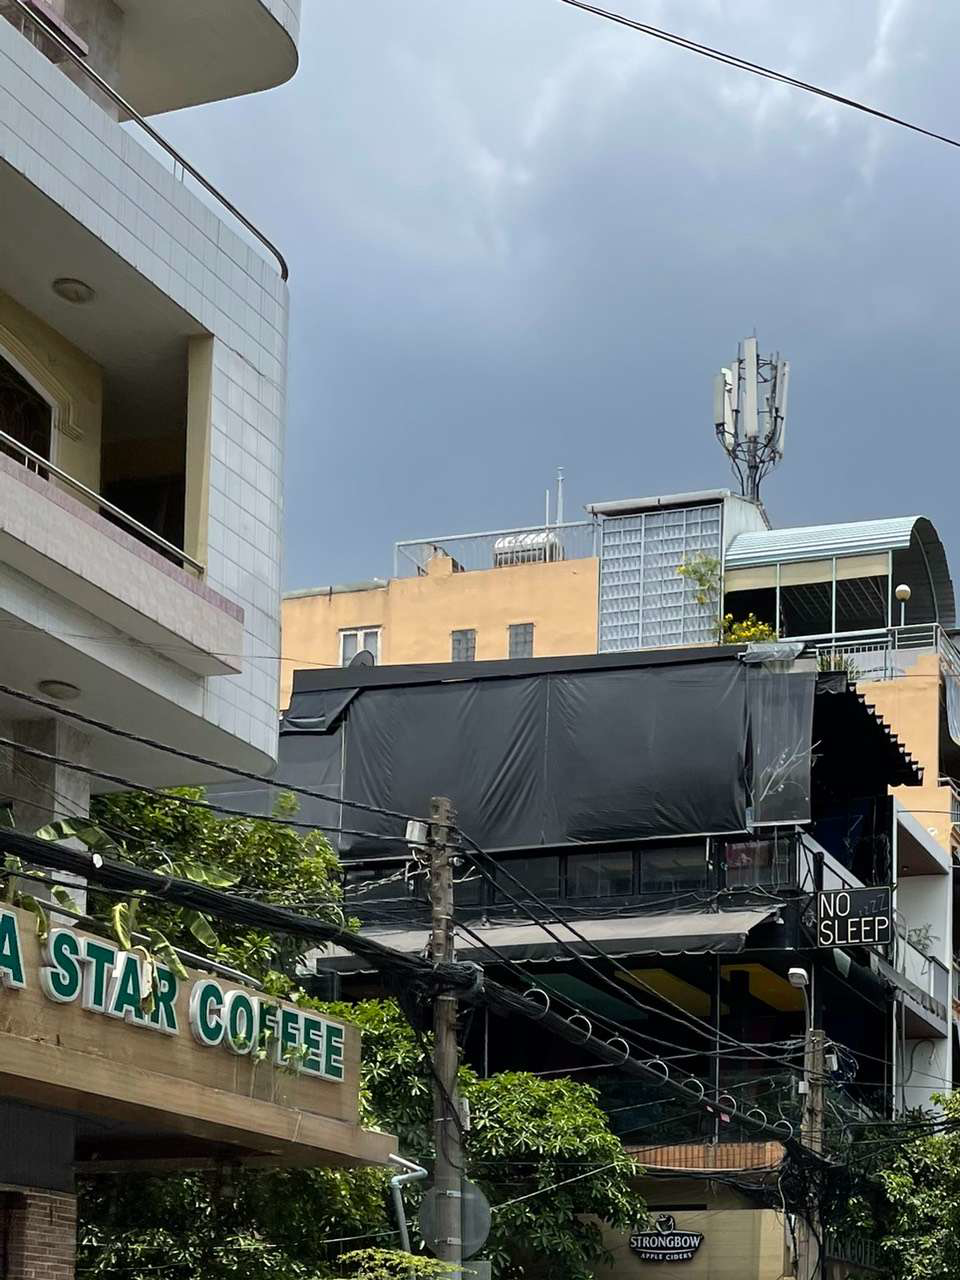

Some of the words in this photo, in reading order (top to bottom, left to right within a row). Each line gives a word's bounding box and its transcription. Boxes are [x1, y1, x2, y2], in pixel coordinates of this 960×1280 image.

[821, 892, 850, 918] NO
[820, 917, 889, 945] SLEEP
[44, 928, 179, 1036] STAR
[190, 980, 345, 1083] COFFEE
[630, 1235, 700, 1248] STRONGBOW
[641, 1252, 662, 1260] APPLE
[666, 1252, 692, 1260] CIDERS
